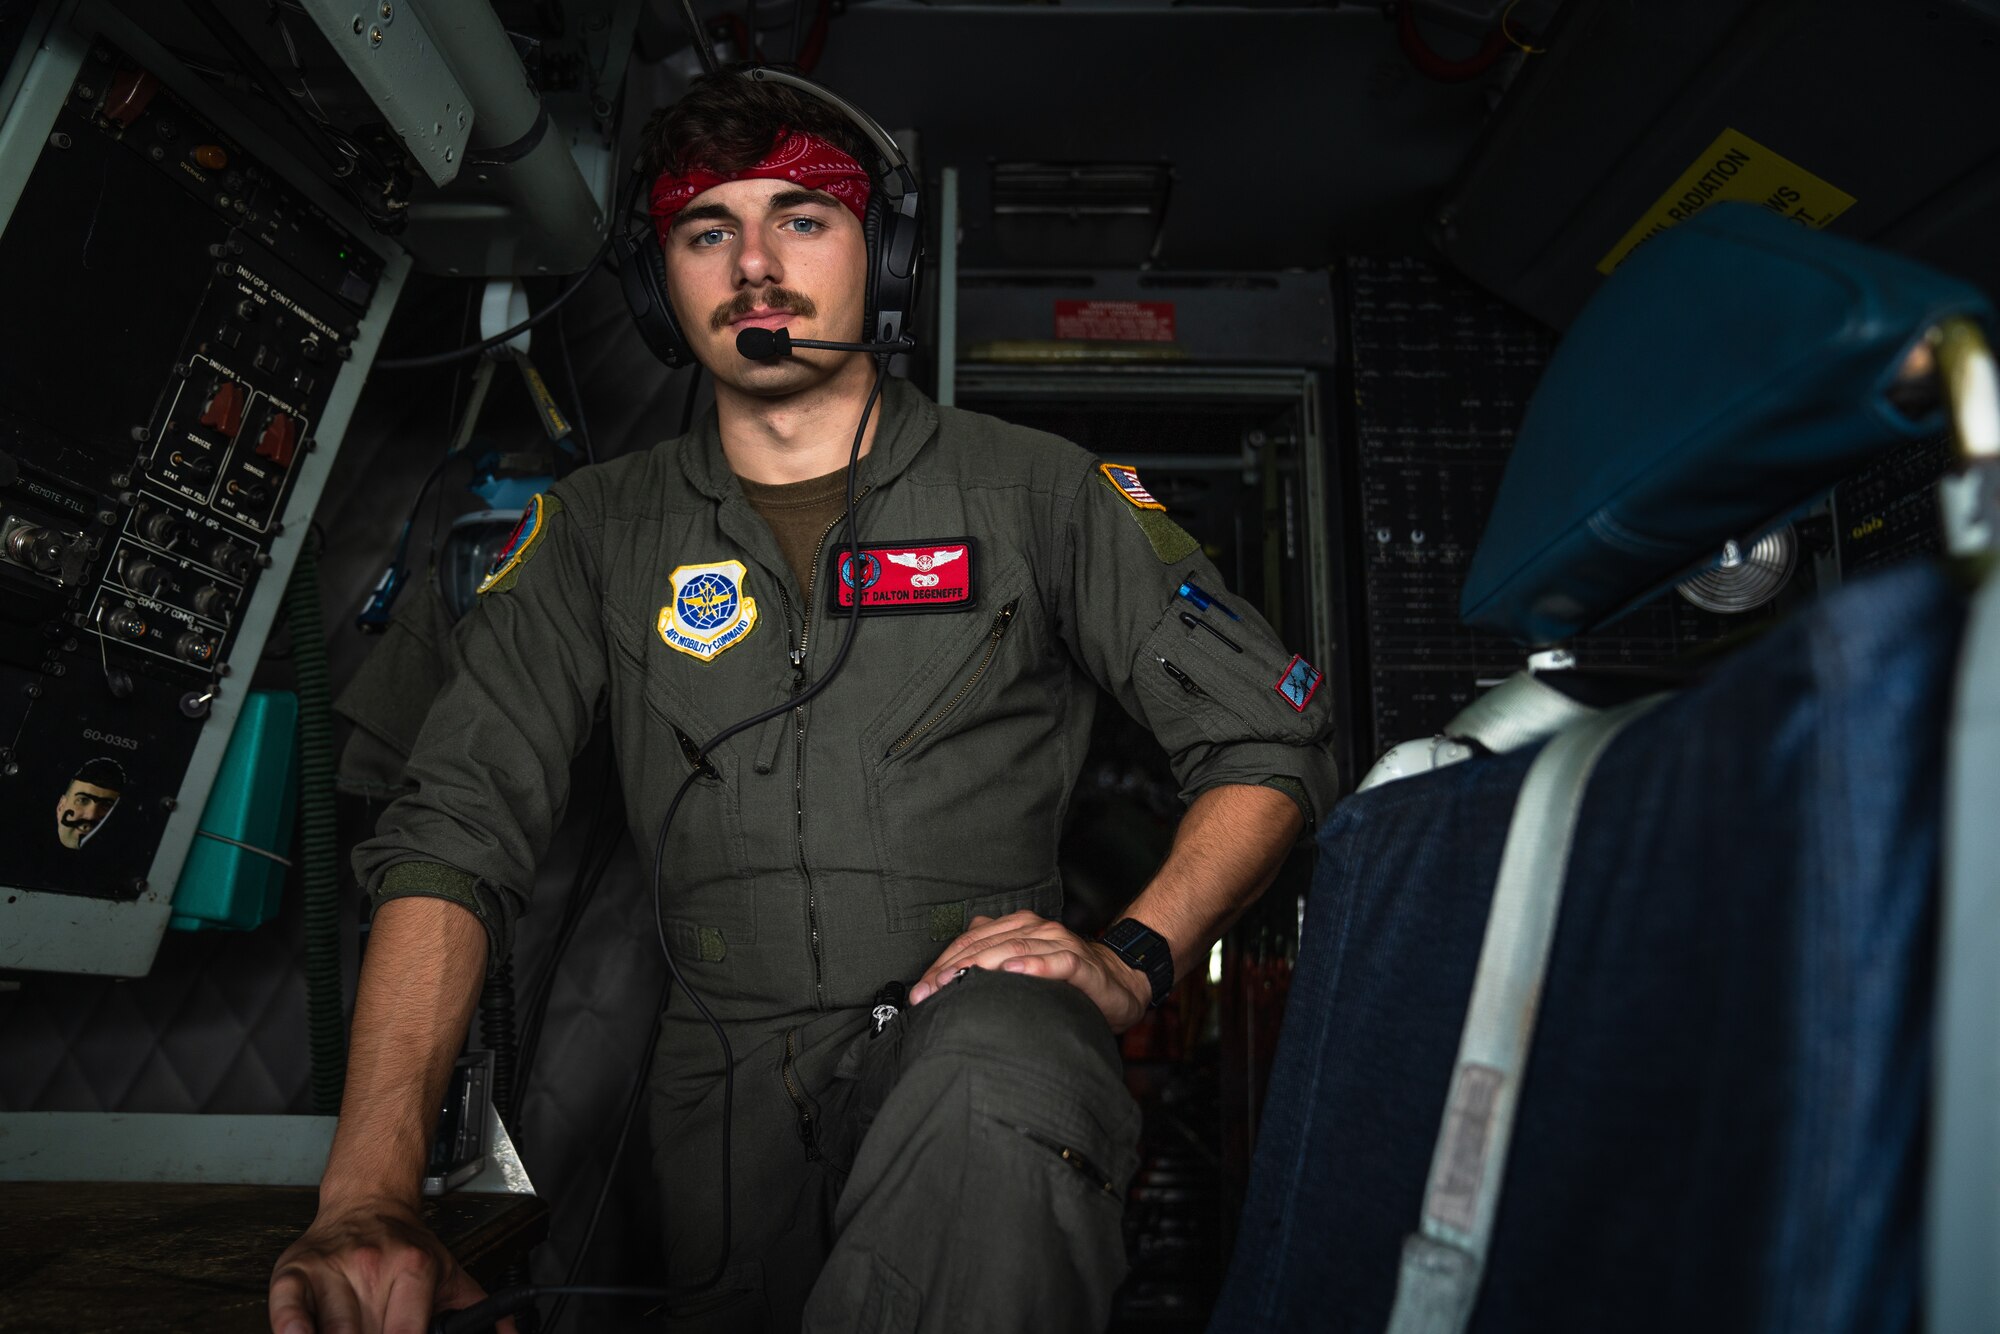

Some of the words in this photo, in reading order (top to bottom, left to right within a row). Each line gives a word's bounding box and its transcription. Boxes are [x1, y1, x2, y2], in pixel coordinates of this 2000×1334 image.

[1668, 147, 1750, 222] RADIATION
[236, 264, 269, 293] INU/GPS
[238, 282, 253, 296] LAMP
[253, 292, 268, 306] TEST
[163, 469, 179, 482] STAT
[28, 482, 62, 505] REMOTE
[63, 495, 86, 514] FILL
[220, 497, 236, 508] STAT
[185, 508, 199, 522] INU
[205, 517, 221, 530] GPS
[179, 560, 190, 569] HF
[873, 589, 910, 602] DALTON
[913, 587, 964, 600] DEGENEFFE
[665, 628, 680, 642] AIR
[677, 636, 713, 654] MOBILITY
[713, 619, 748, 650] COMMAND
[82, 728, 139, 751] 60-0353
